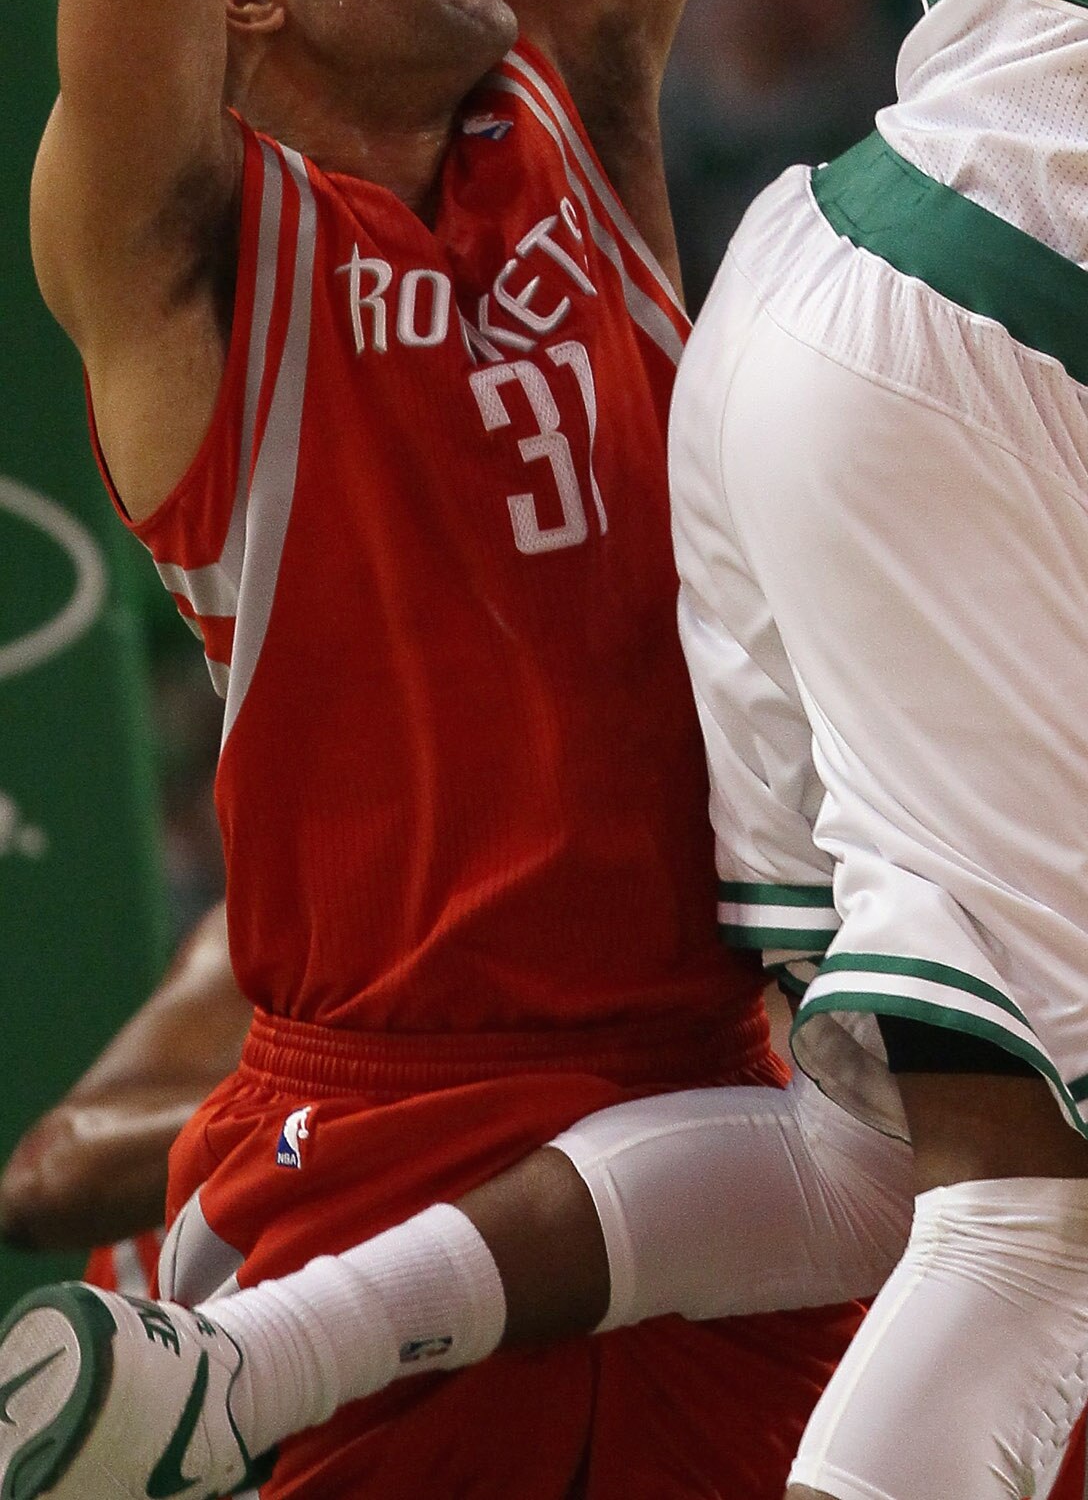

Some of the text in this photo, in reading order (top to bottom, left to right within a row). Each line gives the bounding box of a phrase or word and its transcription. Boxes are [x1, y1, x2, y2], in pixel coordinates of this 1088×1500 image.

[335, 196, 598, 366] ROKET
[468, 339, 609, 556] 31
[277, 1152, 297, 1165] NBA
